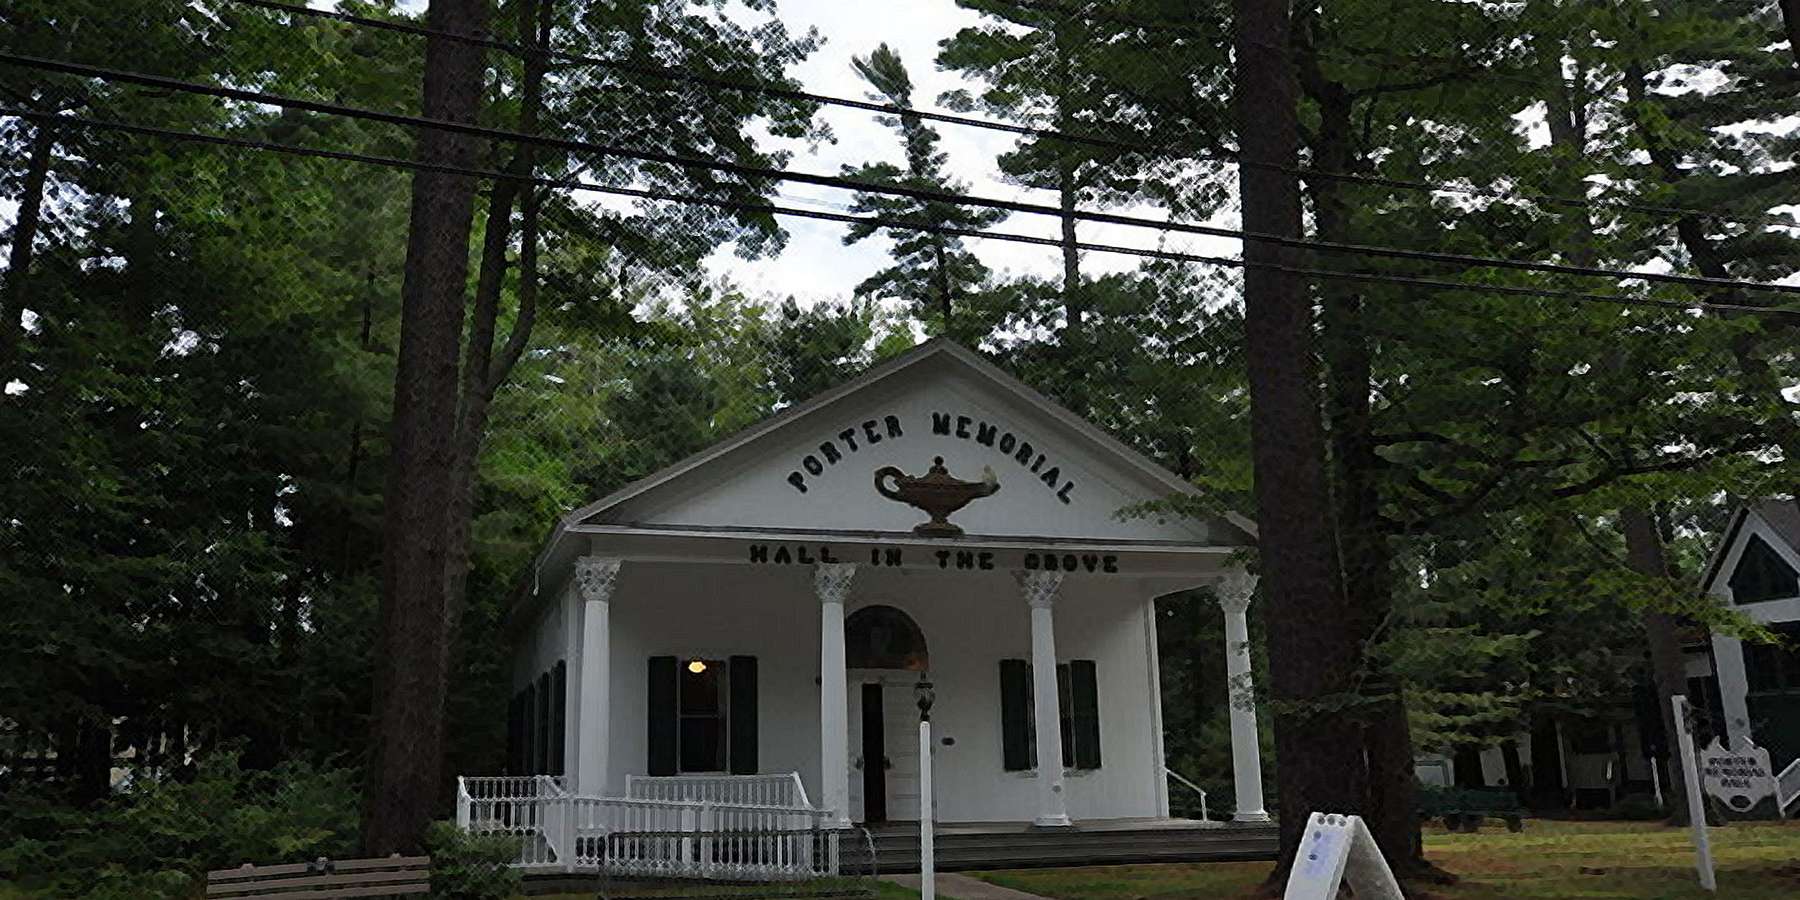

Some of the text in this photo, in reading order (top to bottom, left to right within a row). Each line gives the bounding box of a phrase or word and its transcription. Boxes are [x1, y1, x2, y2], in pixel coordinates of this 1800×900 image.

[787, 412, 1074, 504] PORTER MEMORIAL
[750, 545, 1118, 573] HALL IN THE GROVE
